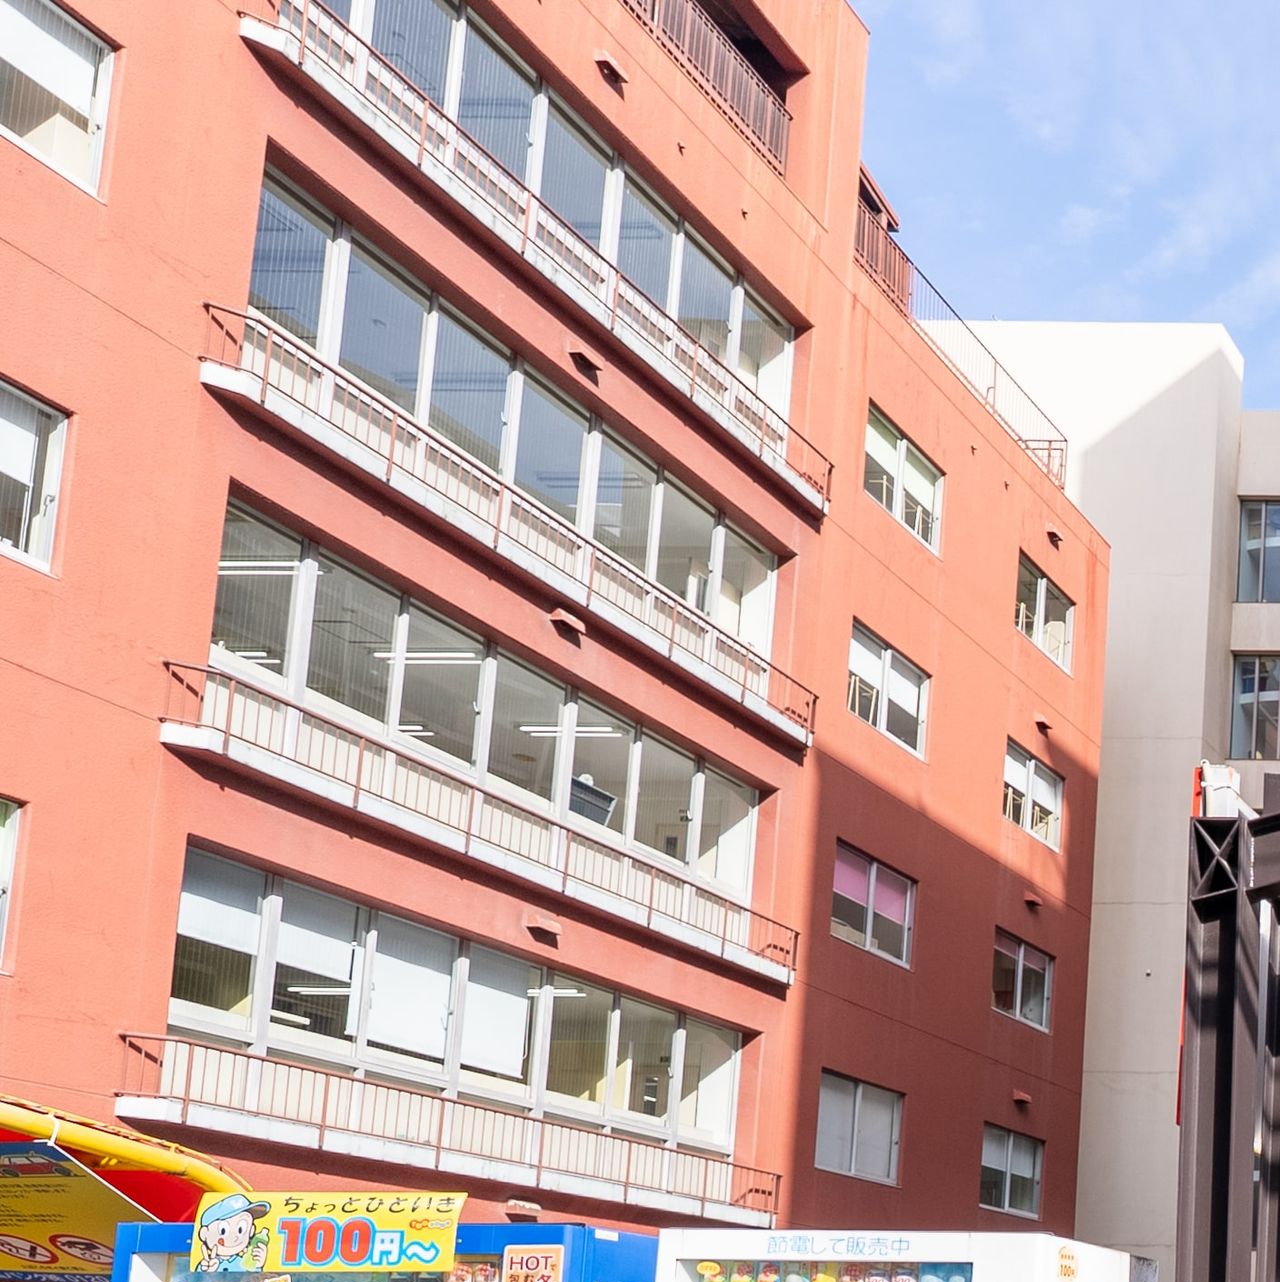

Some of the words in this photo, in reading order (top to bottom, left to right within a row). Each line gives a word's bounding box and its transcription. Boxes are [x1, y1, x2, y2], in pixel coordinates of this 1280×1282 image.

[284, 1196, 455, 1213] ちょっとひといき
[767, 1236, 910, 1255] 節電して販売中
